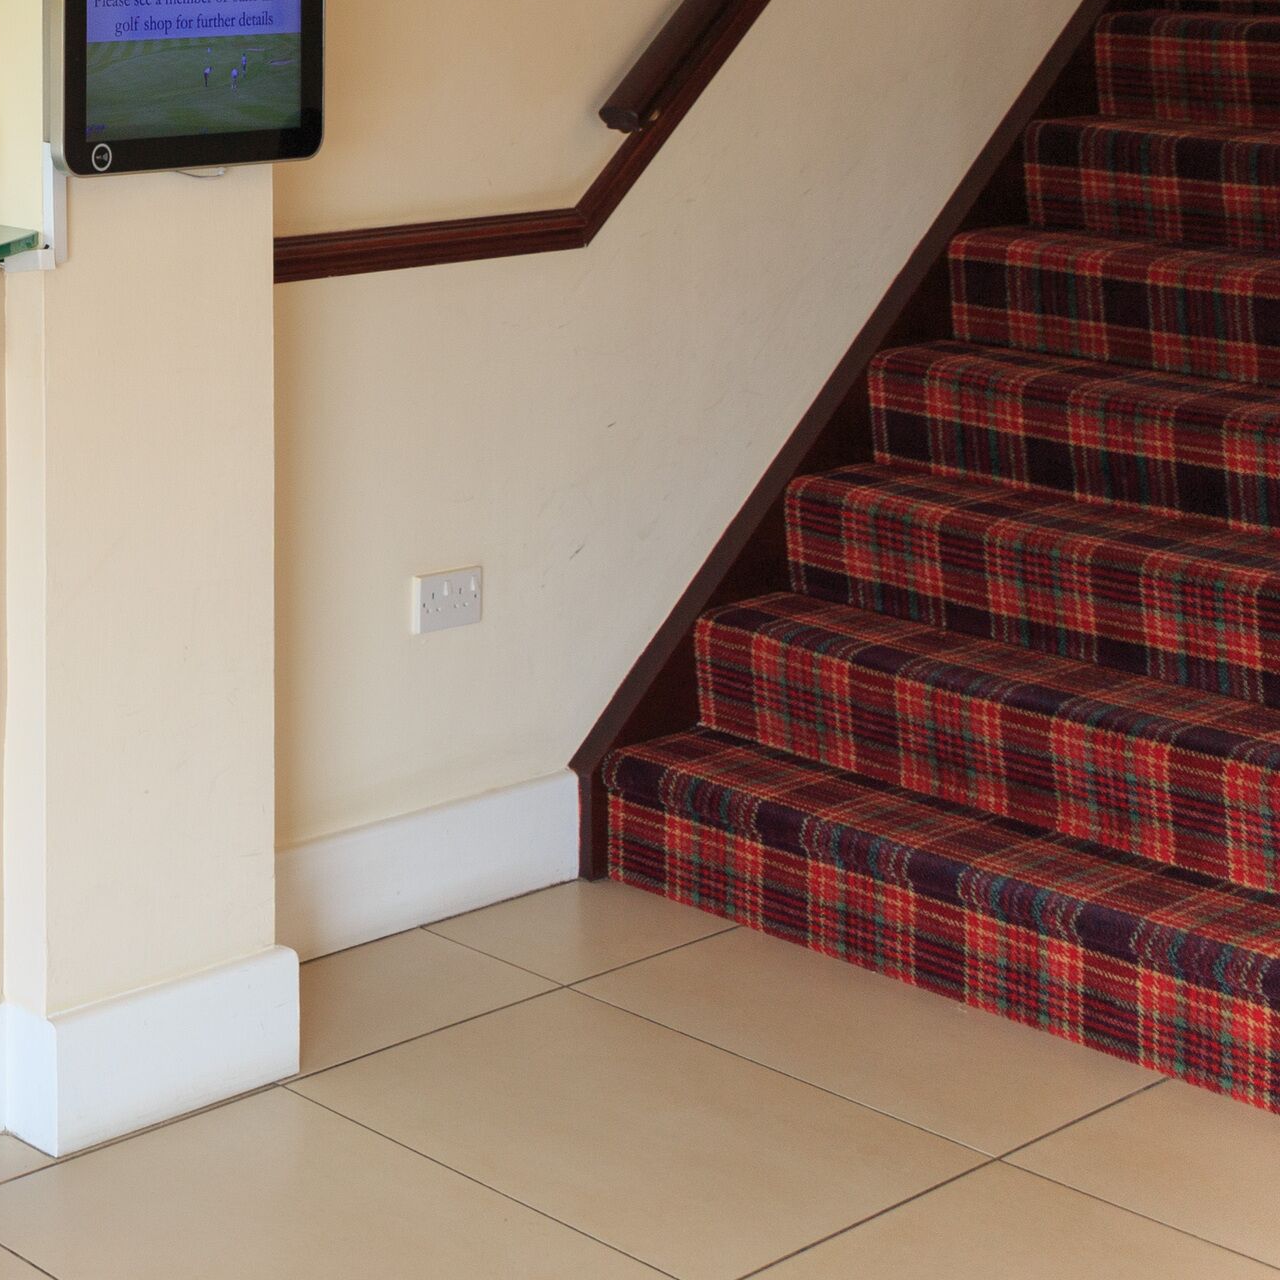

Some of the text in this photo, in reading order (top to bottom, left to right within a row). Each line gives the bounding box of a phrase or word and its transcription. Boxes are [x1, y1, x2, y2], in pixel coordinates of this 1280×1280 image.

[115, 11, 274, 37] golf shop for further details
